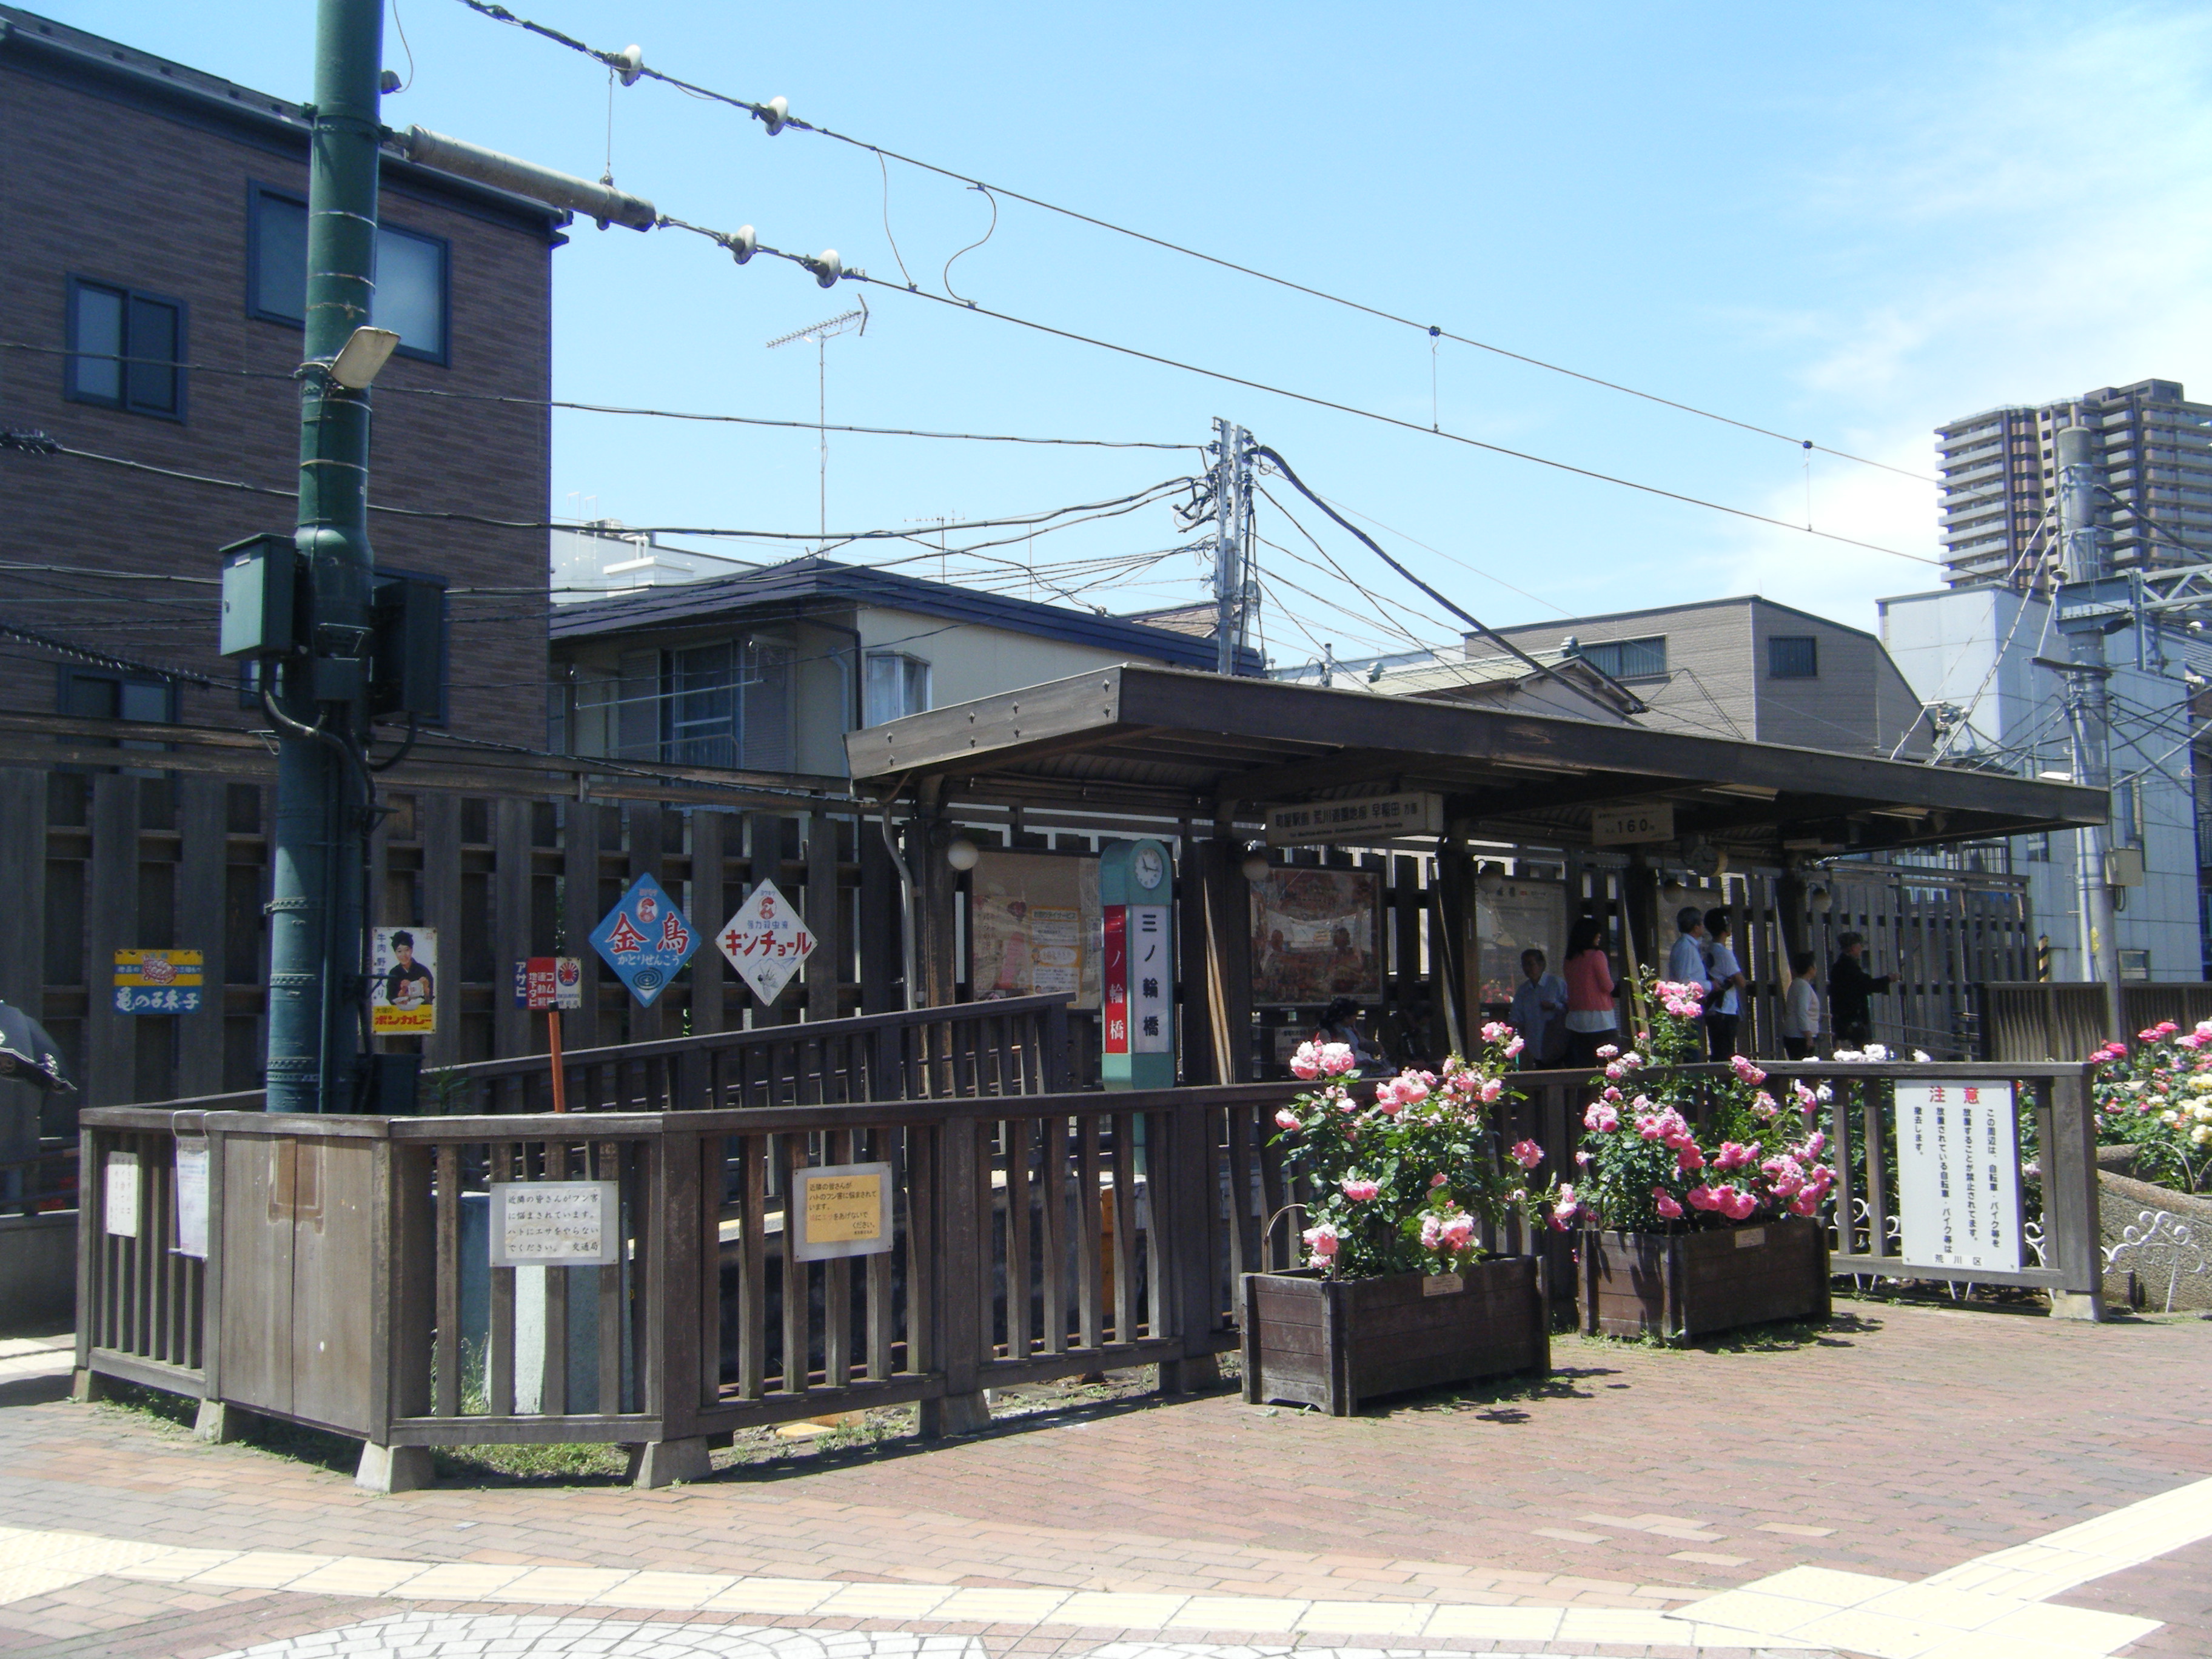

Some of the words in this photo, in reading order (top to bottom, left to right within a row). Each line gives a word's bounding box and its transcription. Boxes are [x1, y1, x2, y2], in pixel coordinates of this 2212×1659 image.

[1372, 801, 1400, 819] 早稲田
[1618, 819, 1647, 834] 160
[605, 911, 689, 954] 金鳥
[725, 929, 813, 957] キンチョール
[617, 954, 680, 966] かとりせんこう
[515, 962, 527, 997] アサヒ
[1109, 914, 1124, 1041] 三ノ輪橋
[1142, 914, 1159, 1037] 三ノ輪橋
[374, 1015, 432, 1025] ボンカレー
[1929, 1086, 1980, 1104] 注意
[508, 1212, 595, 1220] に悩まされています。
[508, 1227, 599, 1236] ハトにエサをやらない
[572, 1242, 599, 1252] 交通局
[1935, 1253, 1982, 1266] 荒川区
